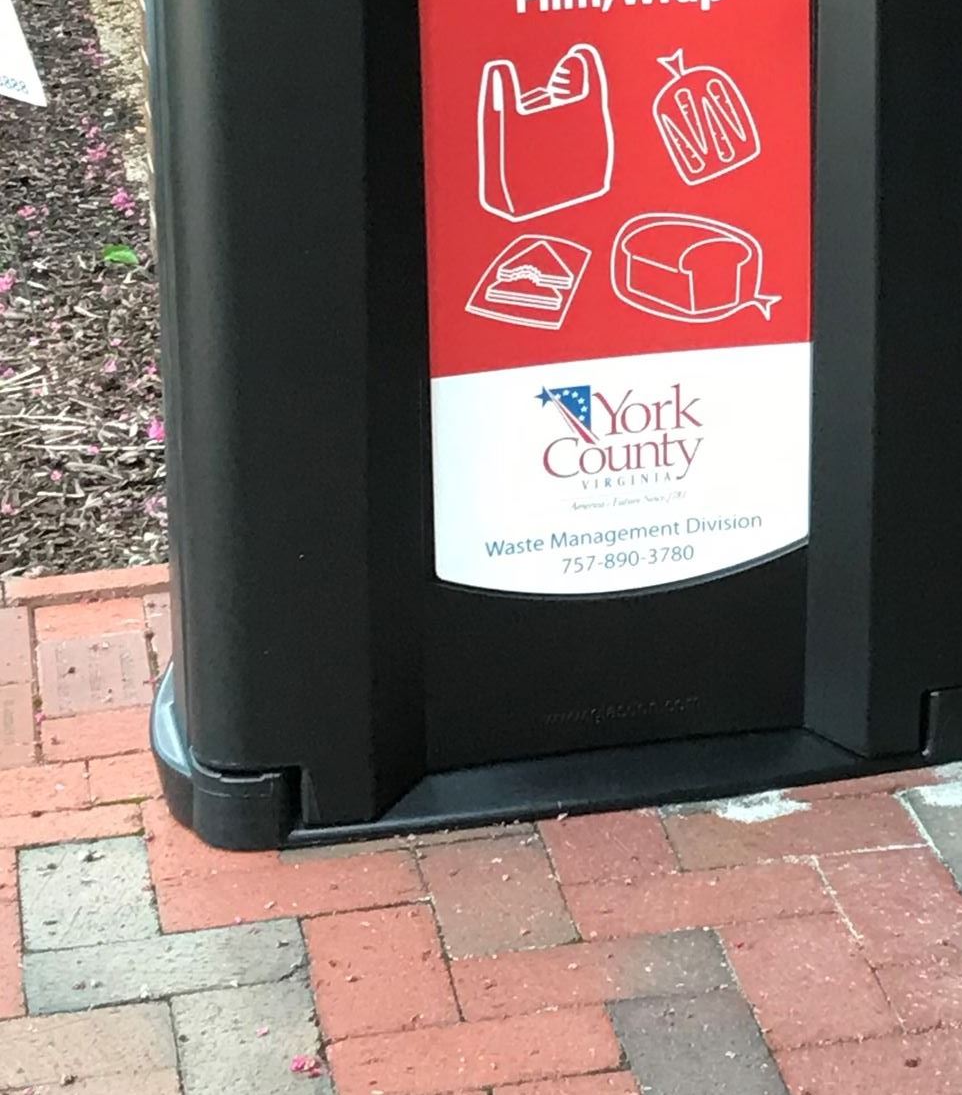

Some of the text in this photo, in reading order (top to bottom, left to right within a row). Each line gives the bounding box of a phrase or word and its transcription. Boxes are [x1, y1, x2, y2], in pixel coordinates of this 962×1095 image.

[592, 383, 703, 436] York
[543, 433, 704, 481] County
[581, 472, 672, 490] VIRGINIA
[485, 514, 763, 558] Waste Management Division
[562, 544, 694, 575] 757-890-3780
